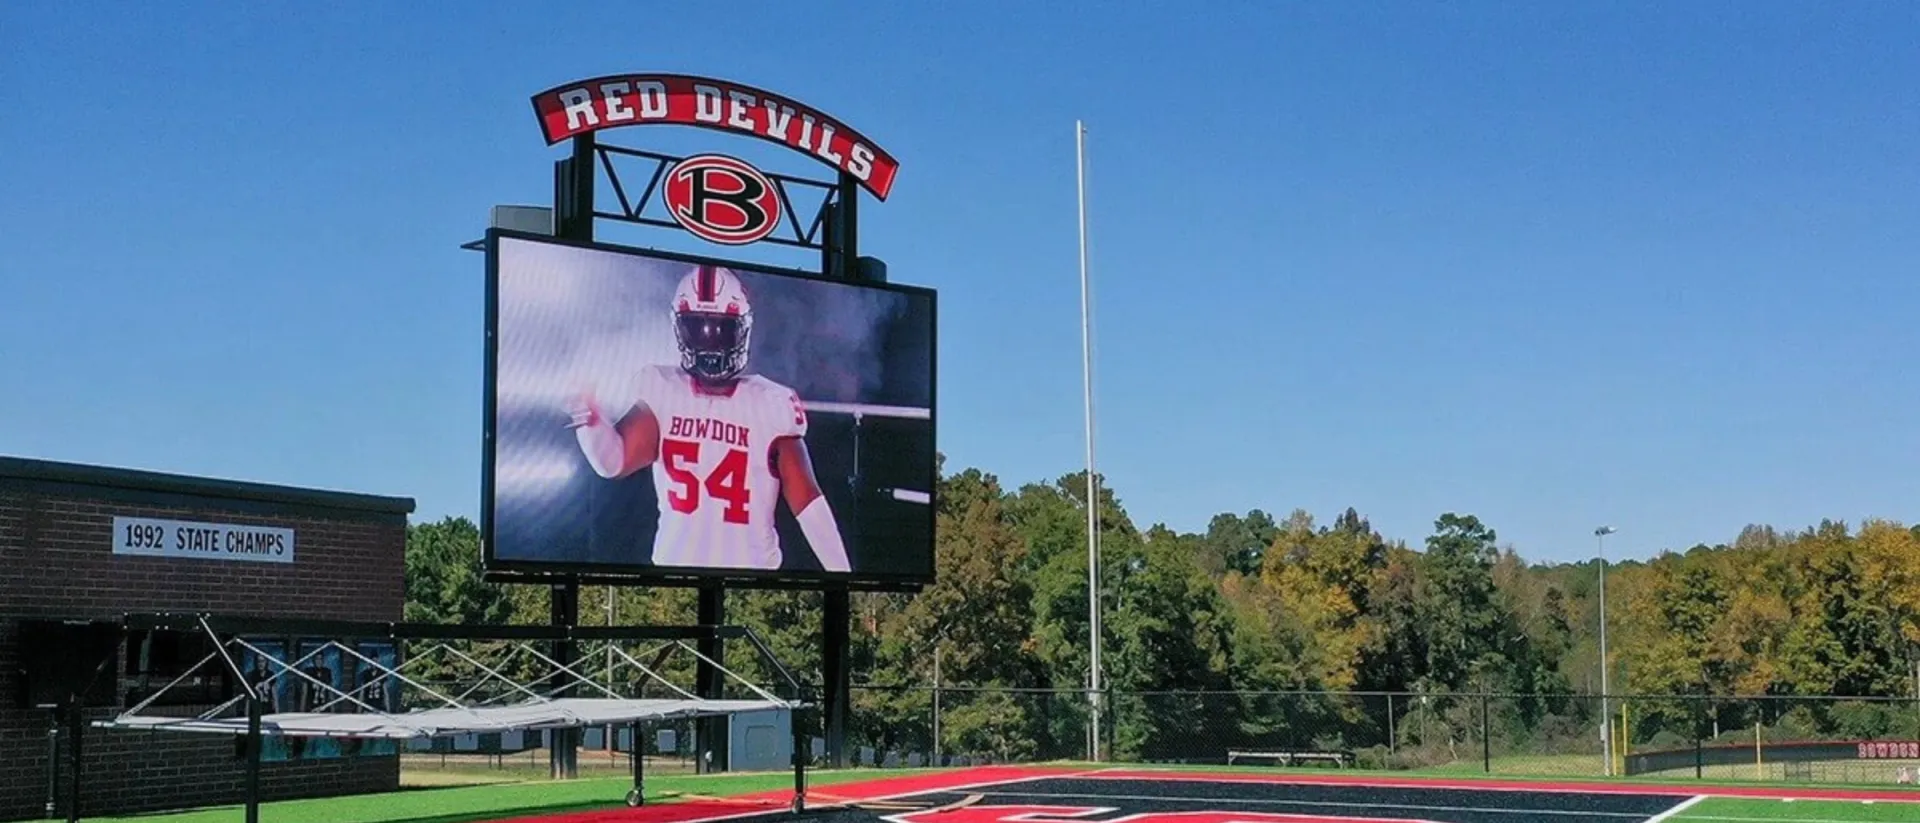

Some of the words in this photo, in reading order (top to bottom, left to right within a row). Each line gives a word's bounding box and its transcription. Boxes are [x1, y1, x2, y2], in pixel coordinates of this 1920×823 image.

[558, 79, 668, 131] RED
[693, 83, 876, 182] DEVILS
[677, 165, 766, 233] B
[669, 416, 750, 448] BOWDON
[661, 438, 750, 525] 54
[125, 523, 164, 549] 1992
[176, 526, 220, 552] STATE
[225, 530, 285, 557] CHAMPS
[1858, 742, 1919, 758] BOWDON
